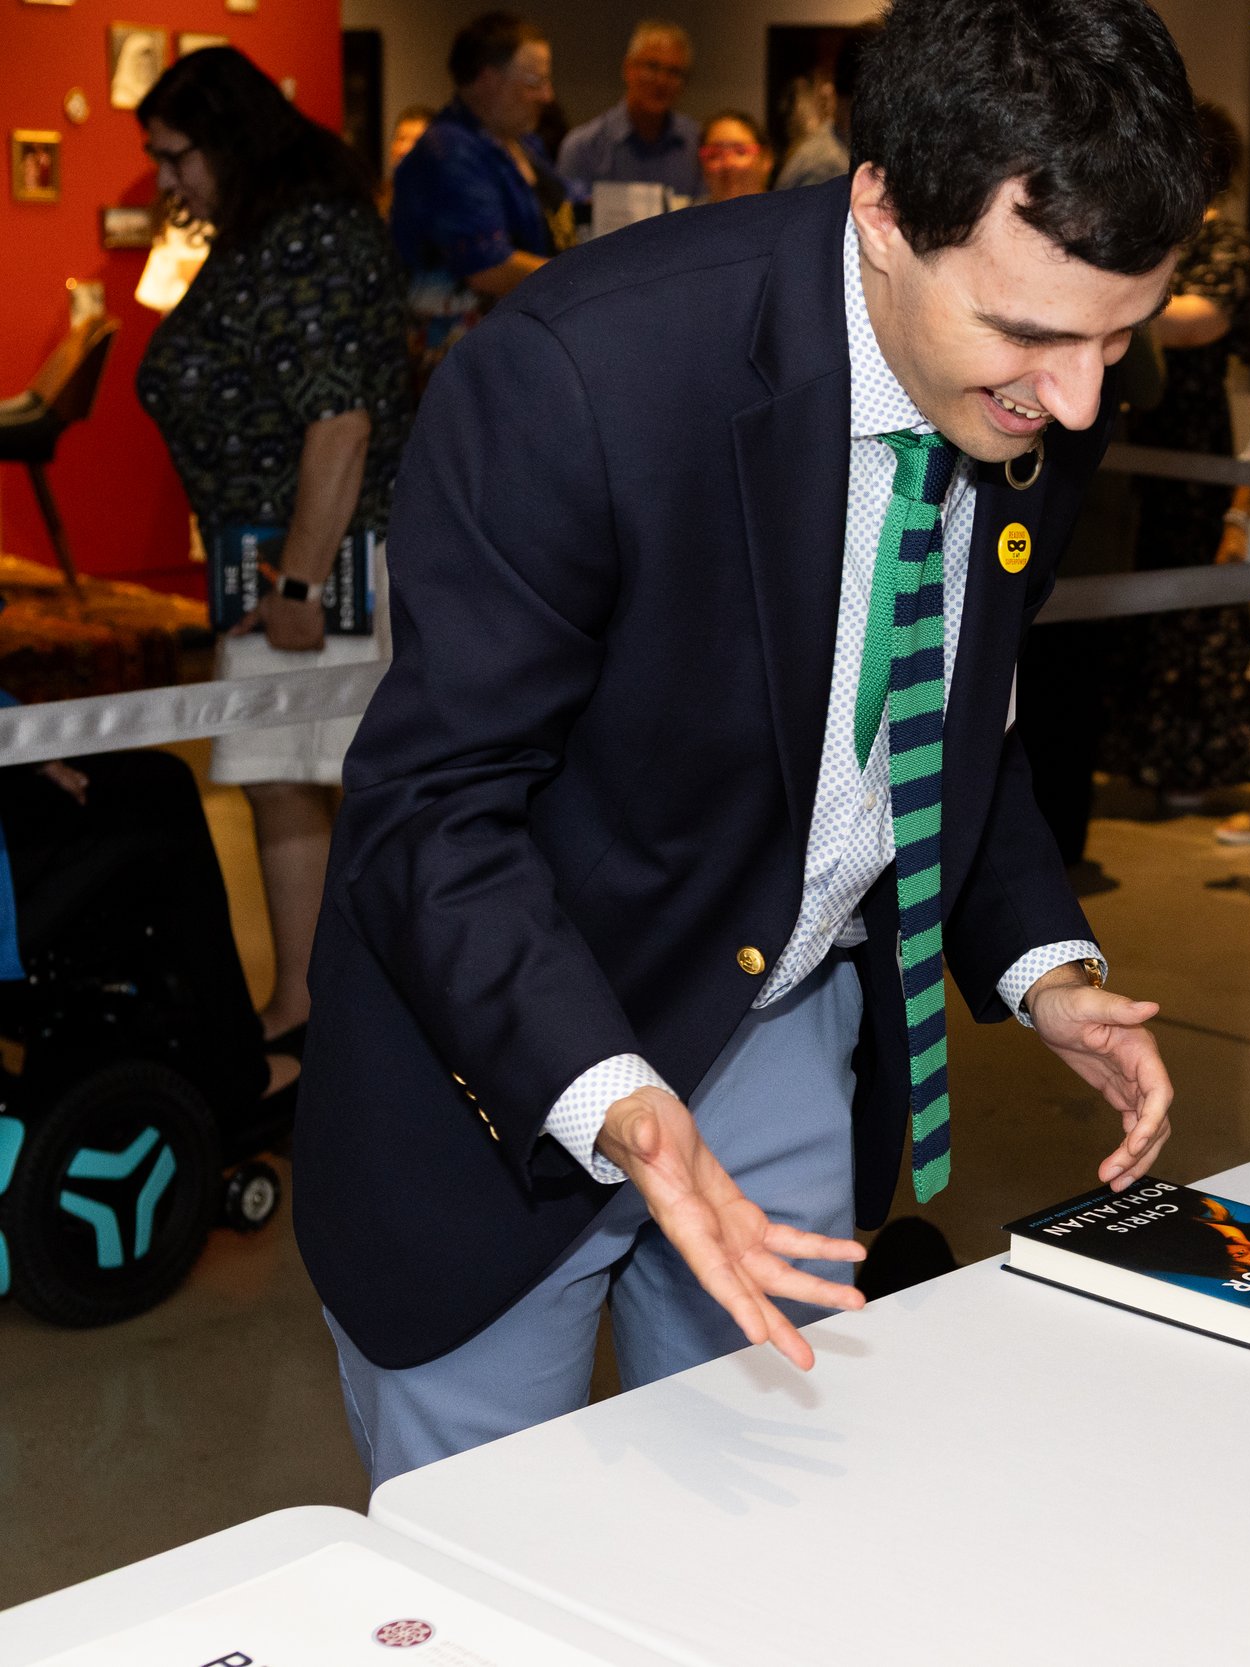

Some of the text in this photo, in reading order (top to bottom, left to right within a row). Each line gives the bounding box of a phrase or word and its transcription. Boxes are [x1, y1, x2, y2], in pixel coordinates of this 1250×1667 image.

[241, 533, 258, 612] MATEUR
[1042, 1182, 1178, 1236] BOHJALIAN
[1106, 1203, 1179, 1233] CHRIS
